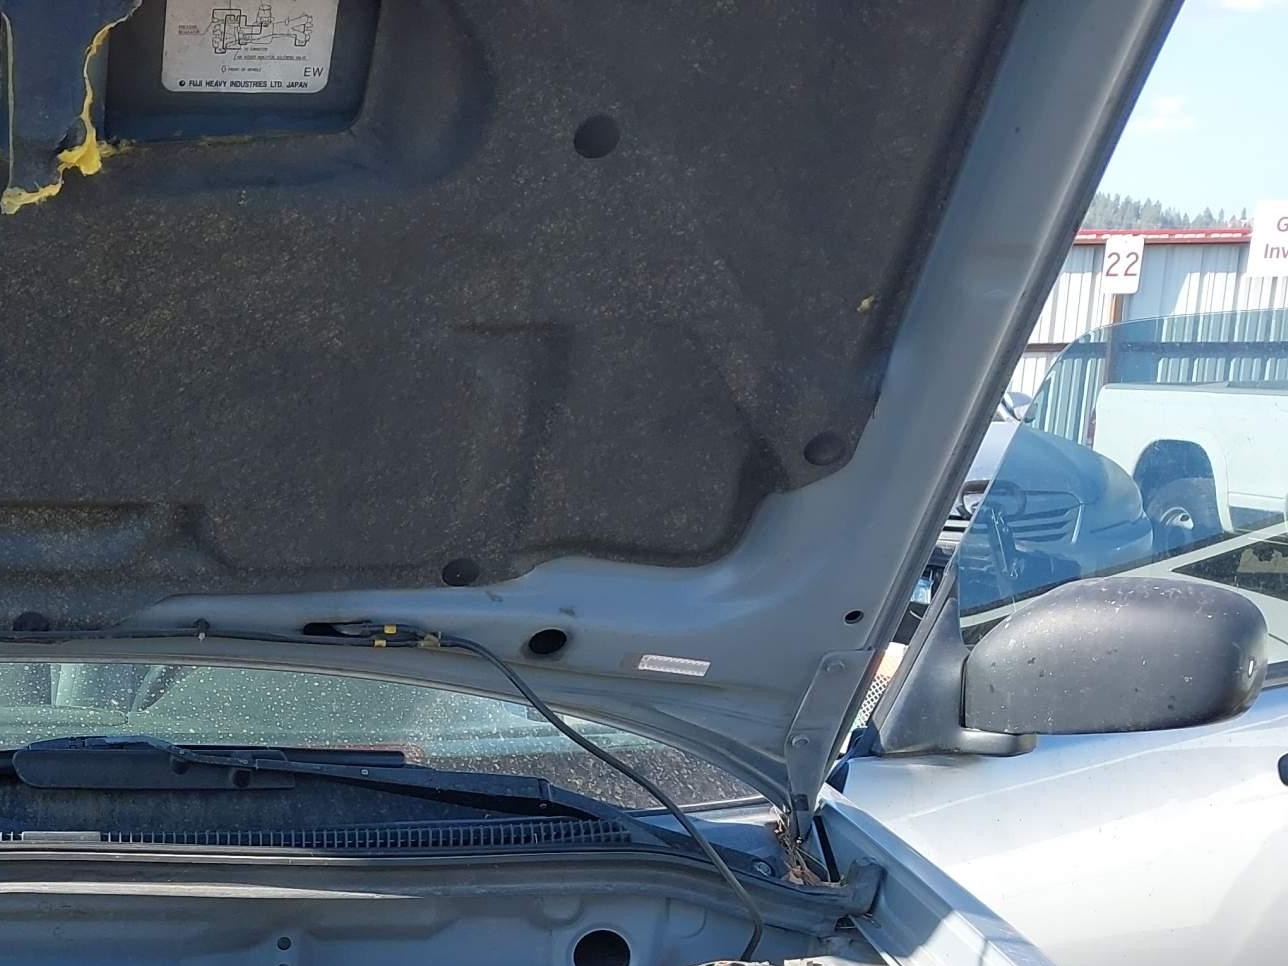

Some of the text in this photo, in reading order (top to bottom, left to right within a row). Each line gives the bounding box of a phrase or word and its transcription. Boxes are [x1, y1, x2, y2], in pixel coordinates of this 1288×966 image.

[303, 66, 324, 77] EW
[188, 80, 203, 88] FUJI
[205, 80, 227, 88] HEAVY
[229, 80, 268, 88] INDUSTRIES
[286, 80, 308, 89] JAPAN
[1105, 251, 1139, 276] 22
